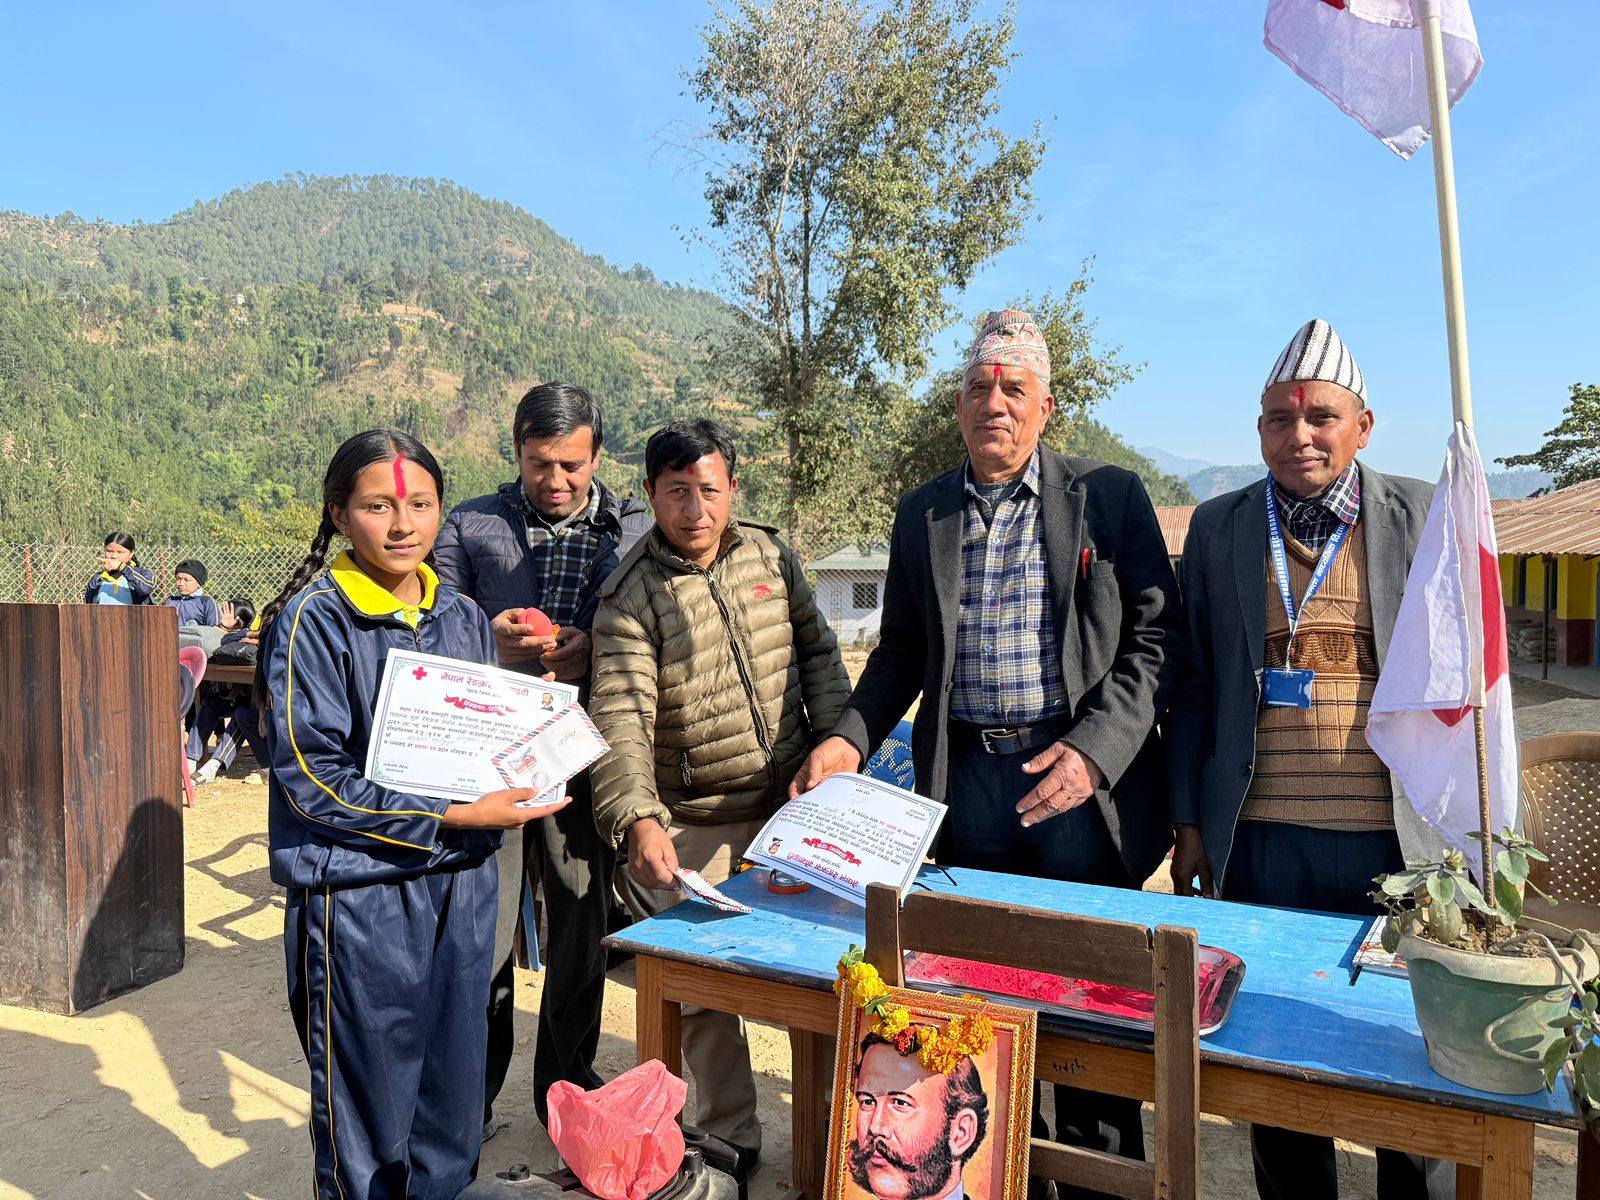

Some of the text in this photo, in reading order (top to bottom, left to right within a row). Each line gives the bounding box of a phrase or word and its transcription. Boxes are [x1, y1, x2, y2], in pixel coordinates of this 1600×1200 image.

[1268, 510, 1280, 548] SECONDARY
[440, 671, 463, 683] नेपाल
[787, 851, 859, 888] नेपाल रेडक्रस सोसाइटी
